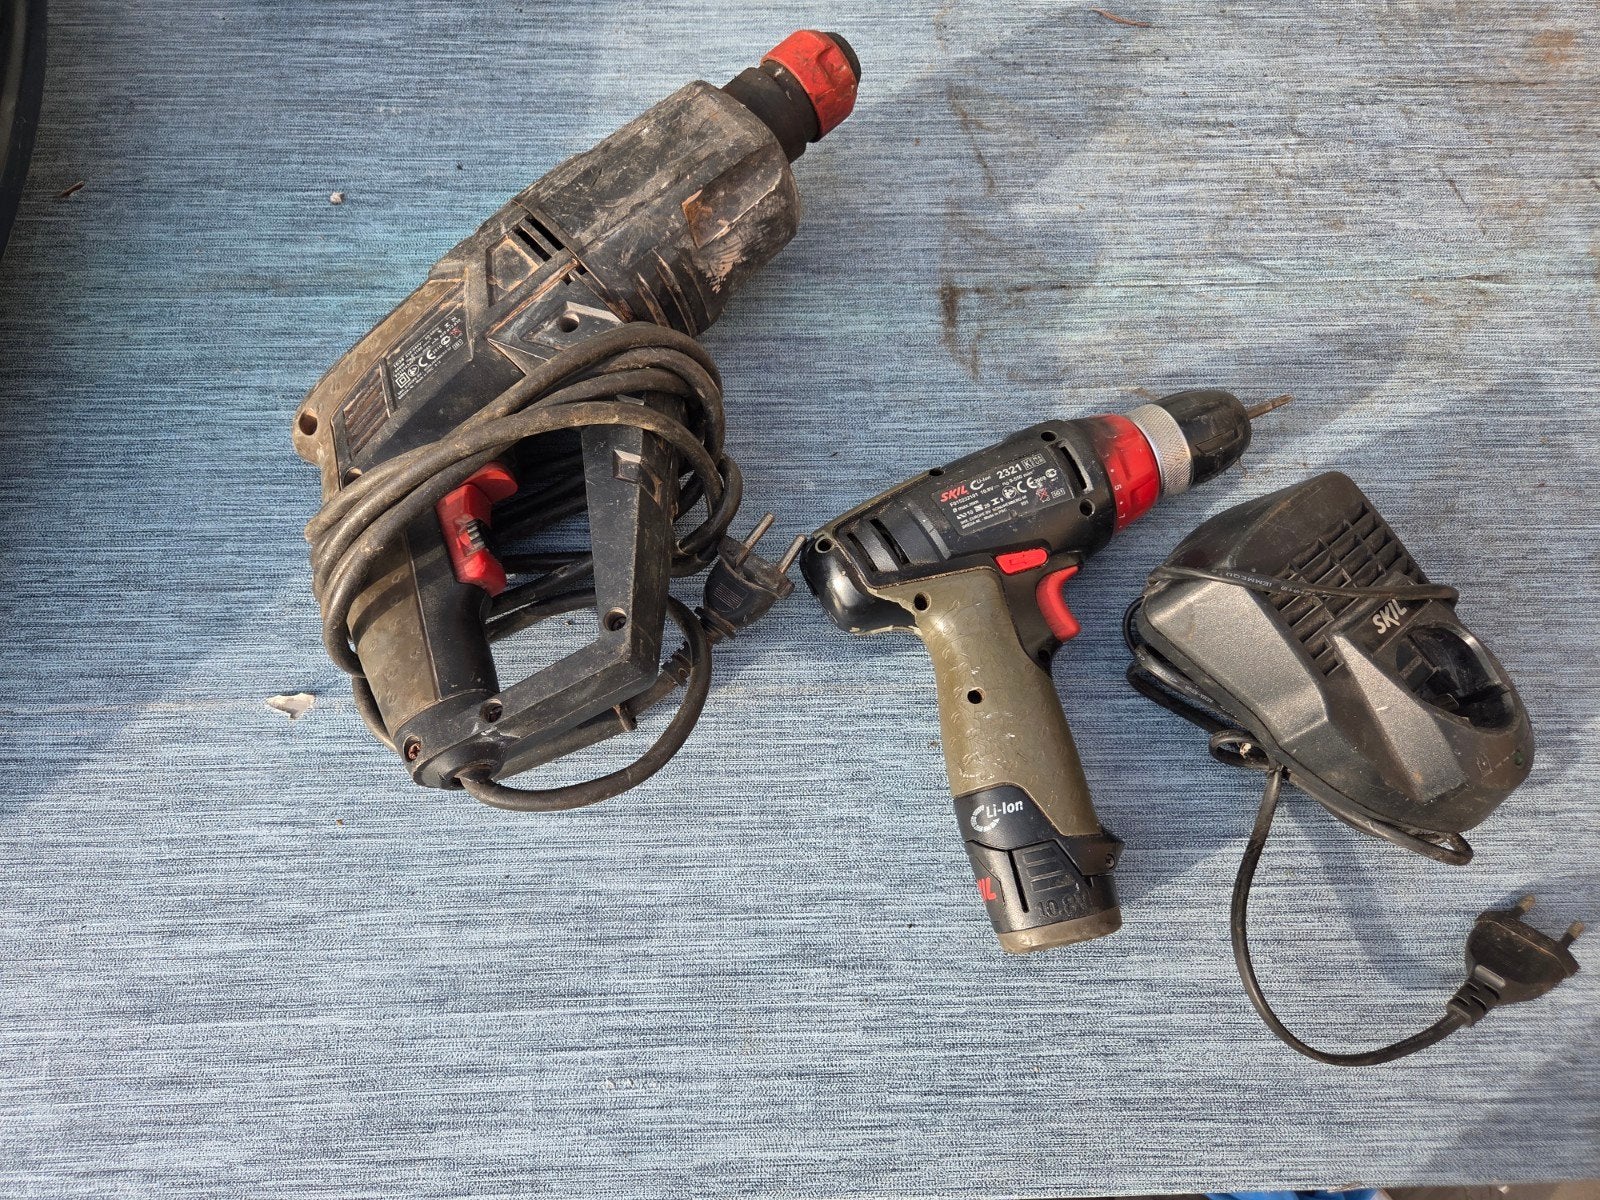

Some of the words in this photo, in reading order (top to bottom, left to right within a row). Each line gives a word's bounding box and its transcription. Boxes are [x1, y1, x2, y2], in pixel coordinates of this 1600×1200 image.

[940, 484, 970, 502] SKIL
[996, 463, 1022, 479] 2321
[1372, 598, 1408, 635] SKIL
[986, 800, 1024, 818] Li-Ion
